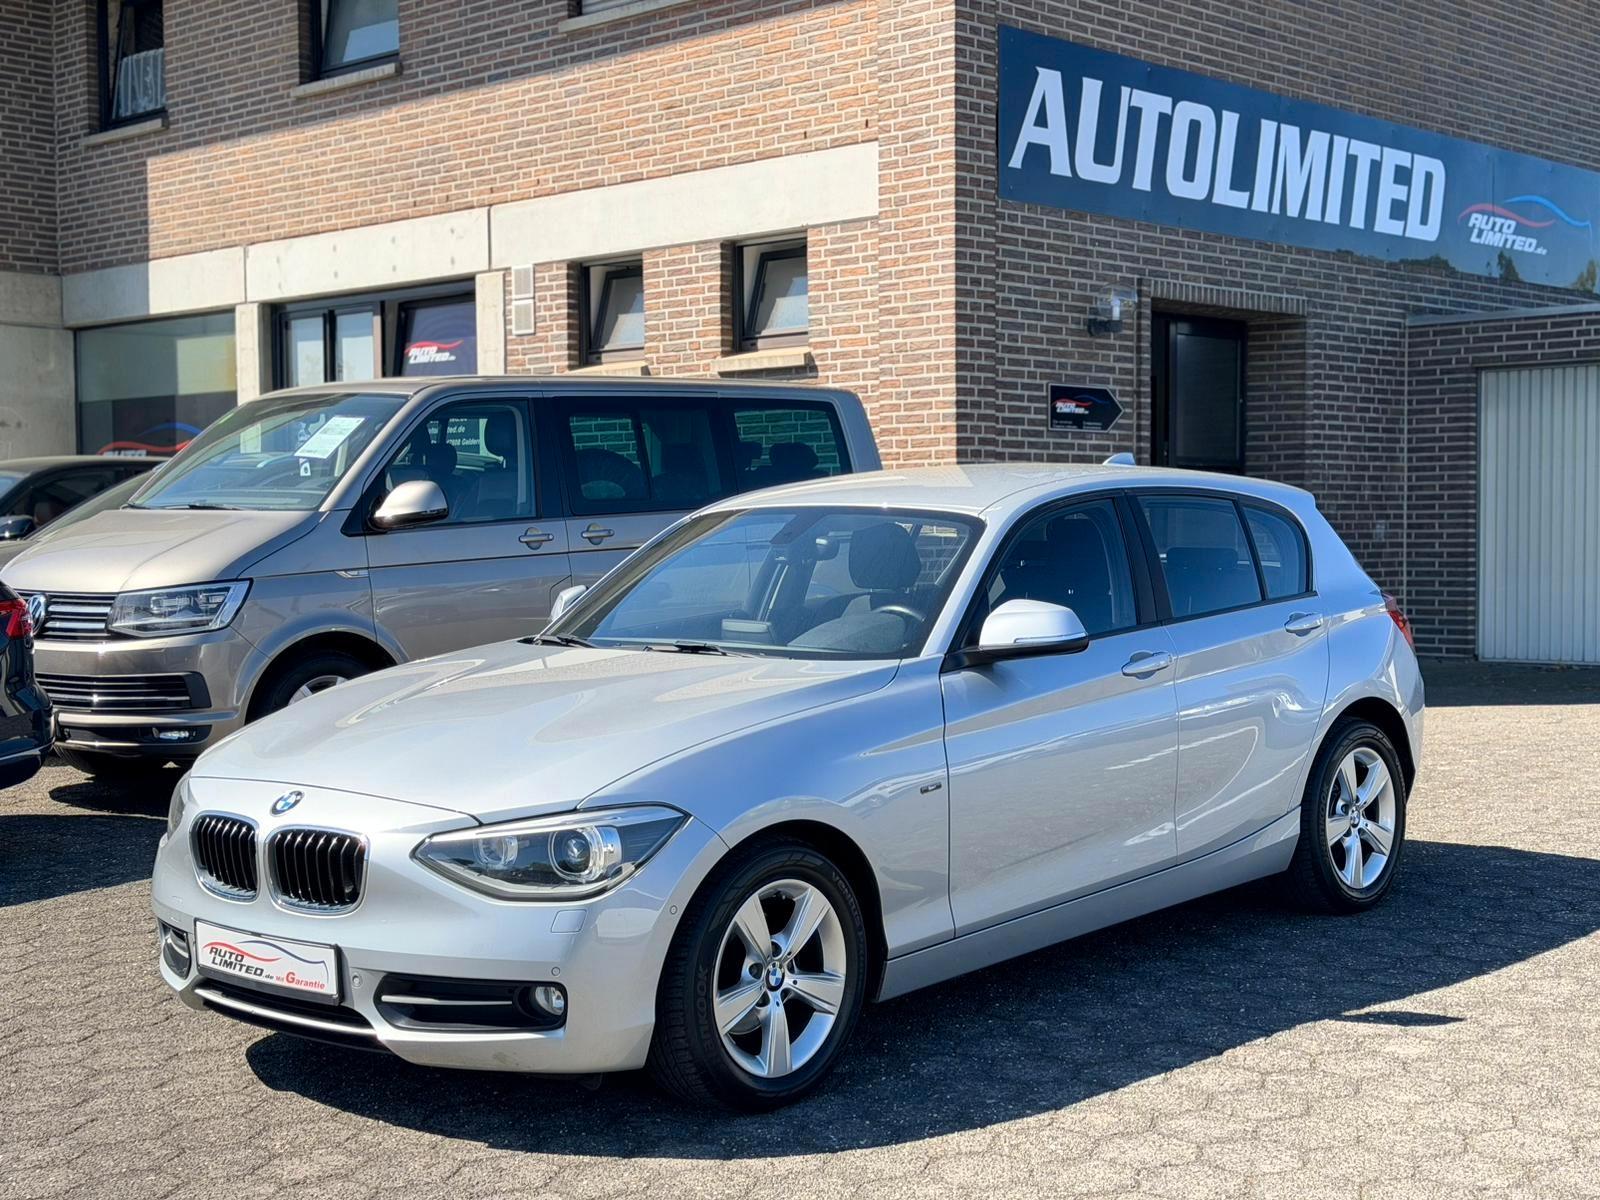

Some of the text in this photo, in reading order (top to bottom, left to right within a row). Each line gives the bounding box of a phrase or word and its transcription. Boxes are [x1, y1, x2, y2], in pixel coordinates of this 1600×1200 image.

[1008, 66, 1446, 242] AUTOLIMITED
[1468, 213, 1516, 234] AUTO
[1470, 228, 1547, 255] LIMITED.de
[408, 346, 438, 357] AUTO
[209, 947, 244, 963] AUTO
[212, 956, 274, 980] LIMITED.de
[286, 971, 326, 990] Garantie
